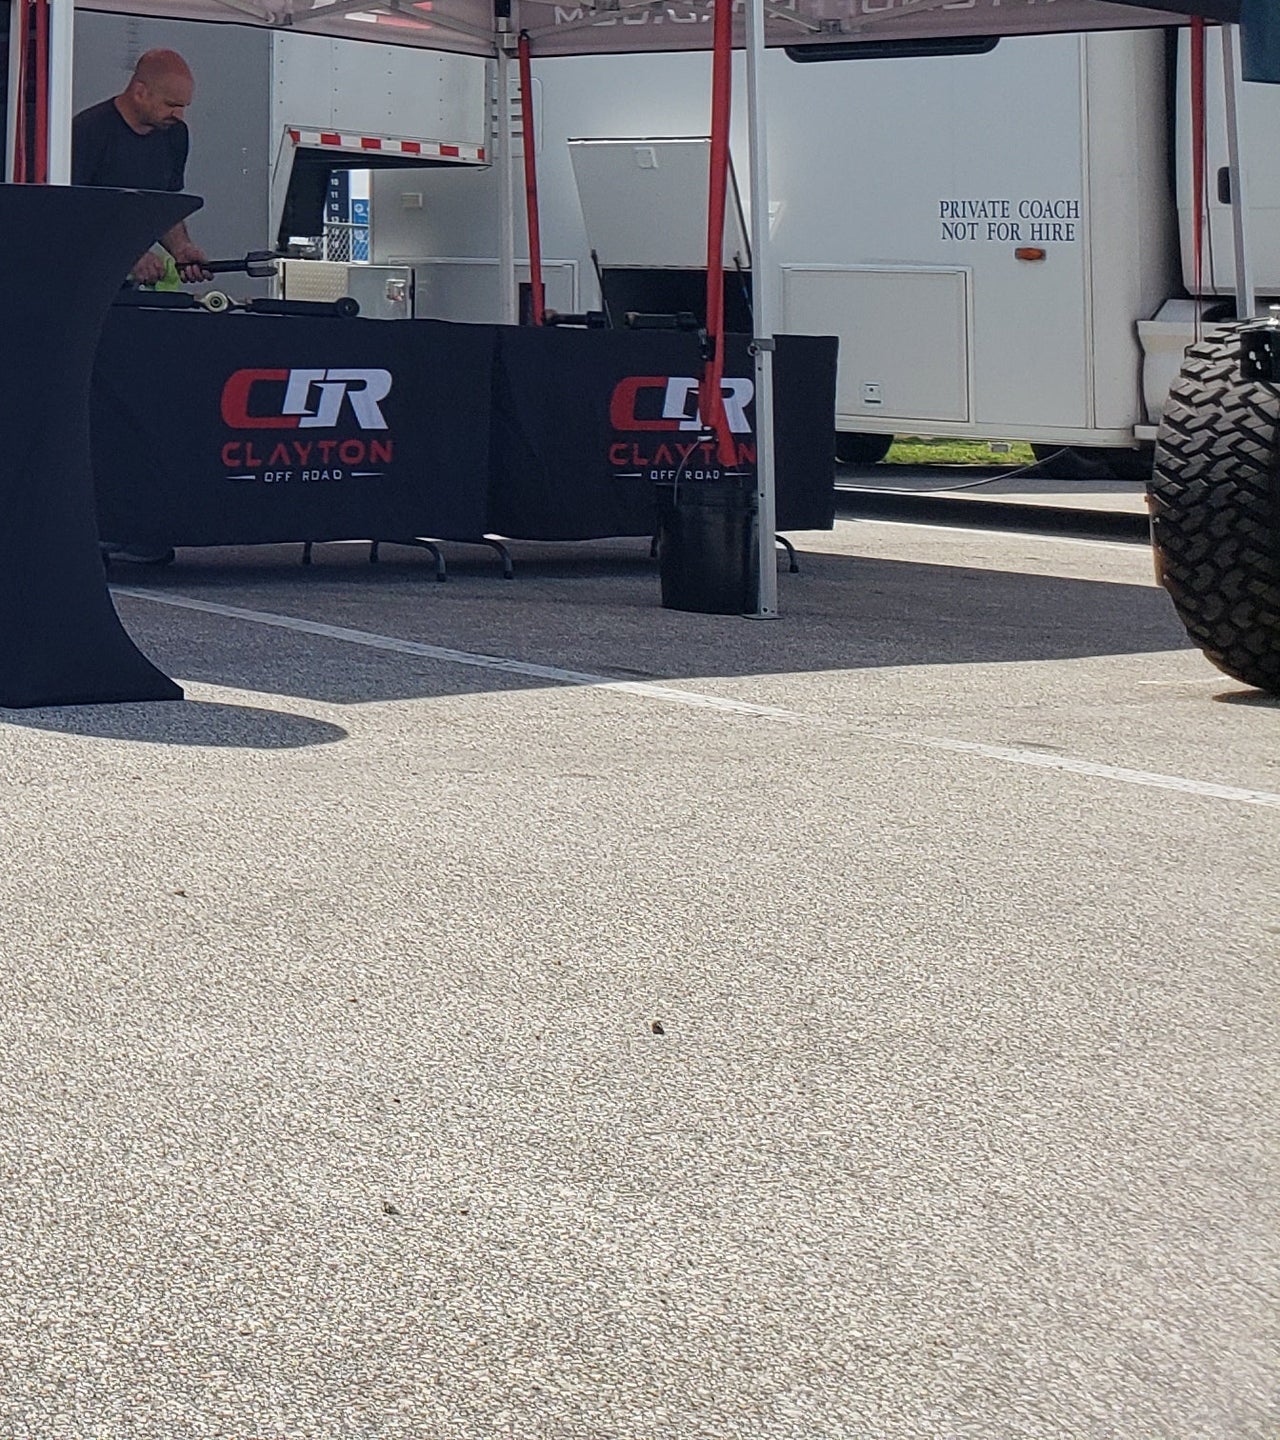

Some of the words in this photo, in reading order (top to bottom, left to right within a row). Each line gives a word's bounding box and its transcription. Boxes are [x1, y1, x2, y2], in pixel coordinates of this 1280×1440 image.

[939, 200, 1010, 219] PRIVATE
[1019, 200, 1080, 219] COACH
[941, 222, 978, 241] NOT
[987, 222, 1022, 241] FOR
[1030, 223, 1075, 242] HIRE
[222, 440, 392, 467] CLAYTON
[608, 442, 757, 467] CLAYTN
[264, 471, 293, 483] OFF
[302, 469, 342, 481] ROAD
[651, 470, 676, 480] OFF
[685, 470, 720, 480] ROAD
